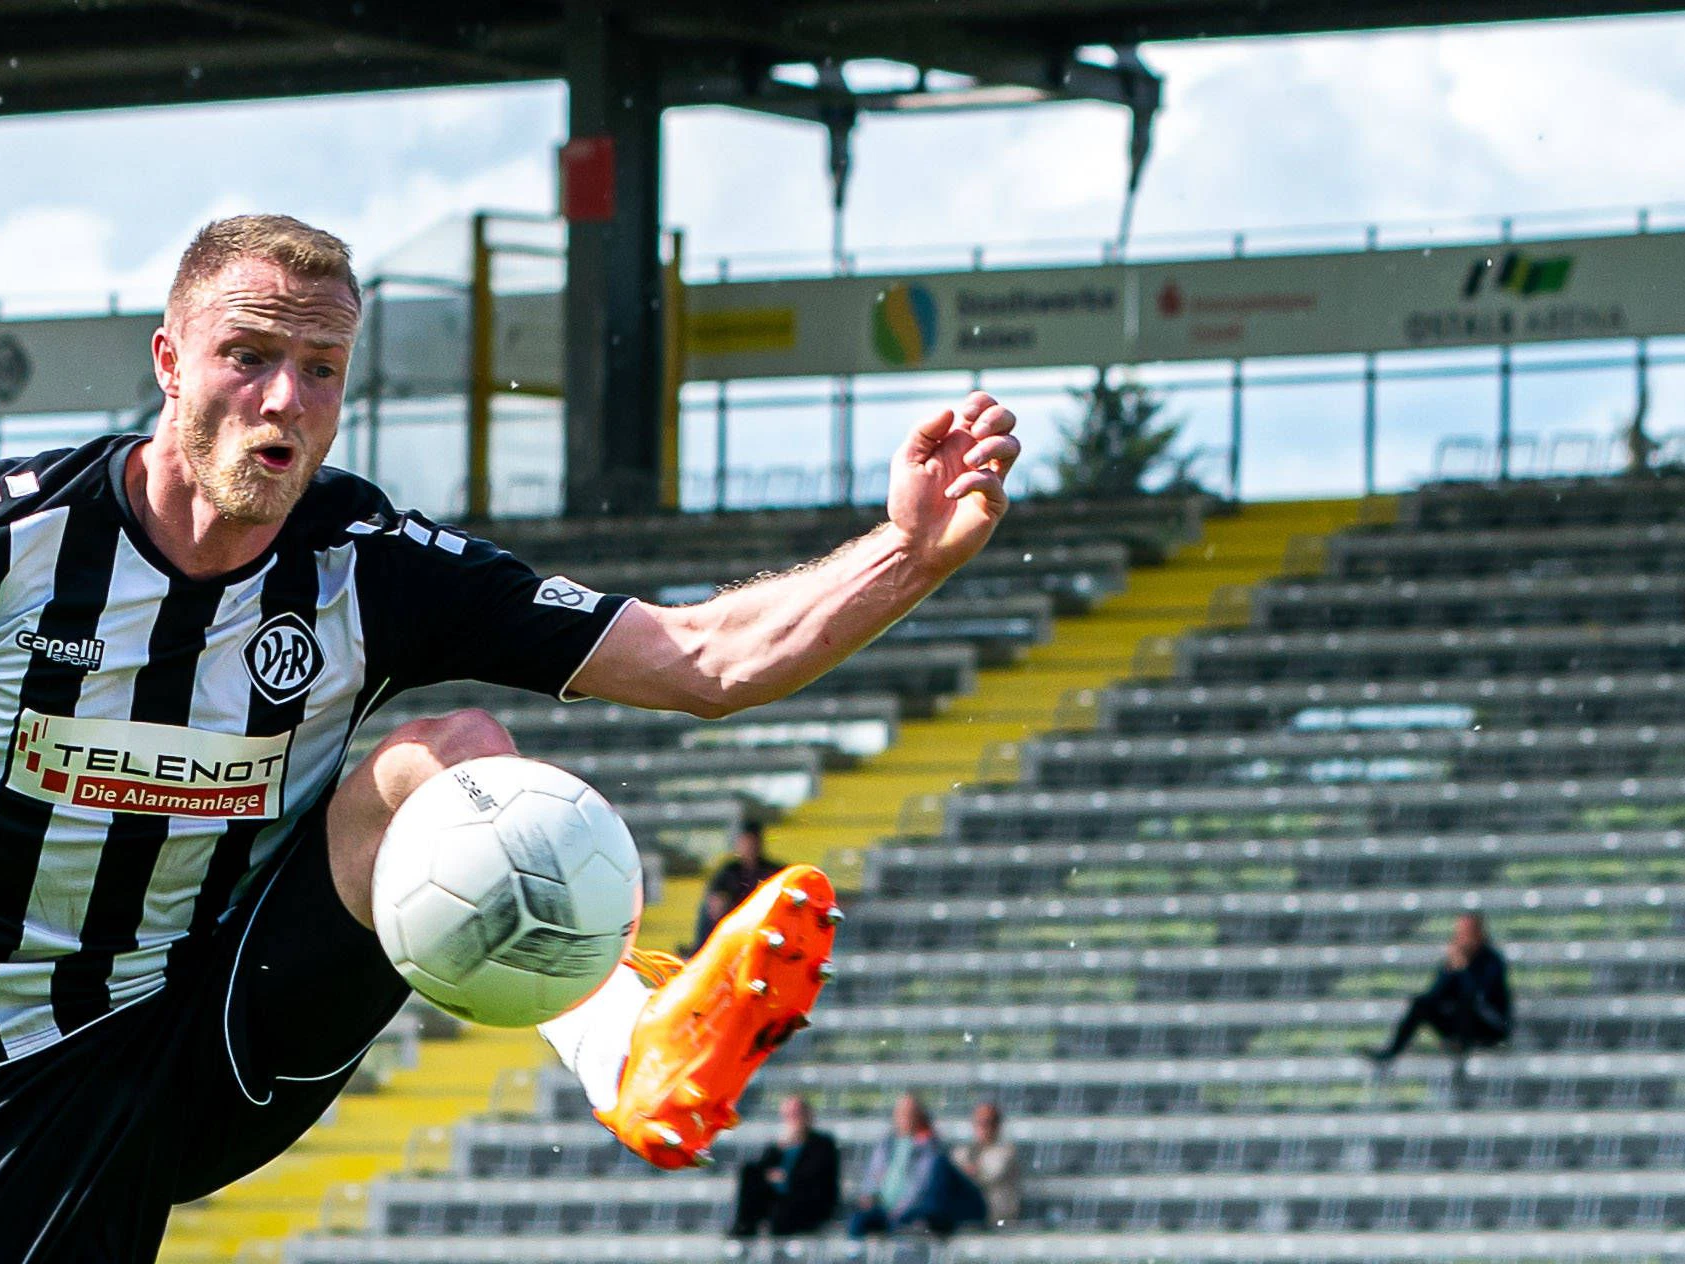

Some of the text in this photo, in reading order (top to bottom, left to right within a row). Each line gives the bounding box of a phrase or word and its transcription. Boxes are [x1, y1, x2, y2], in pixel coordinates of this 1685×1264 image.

[18, 632, 102, 660] capelli
[52, 652, 99, 668] SPORT
[54, 743, 283, 783] TELENOT
[80, 783, 260, 815] Die Alarmanlage
